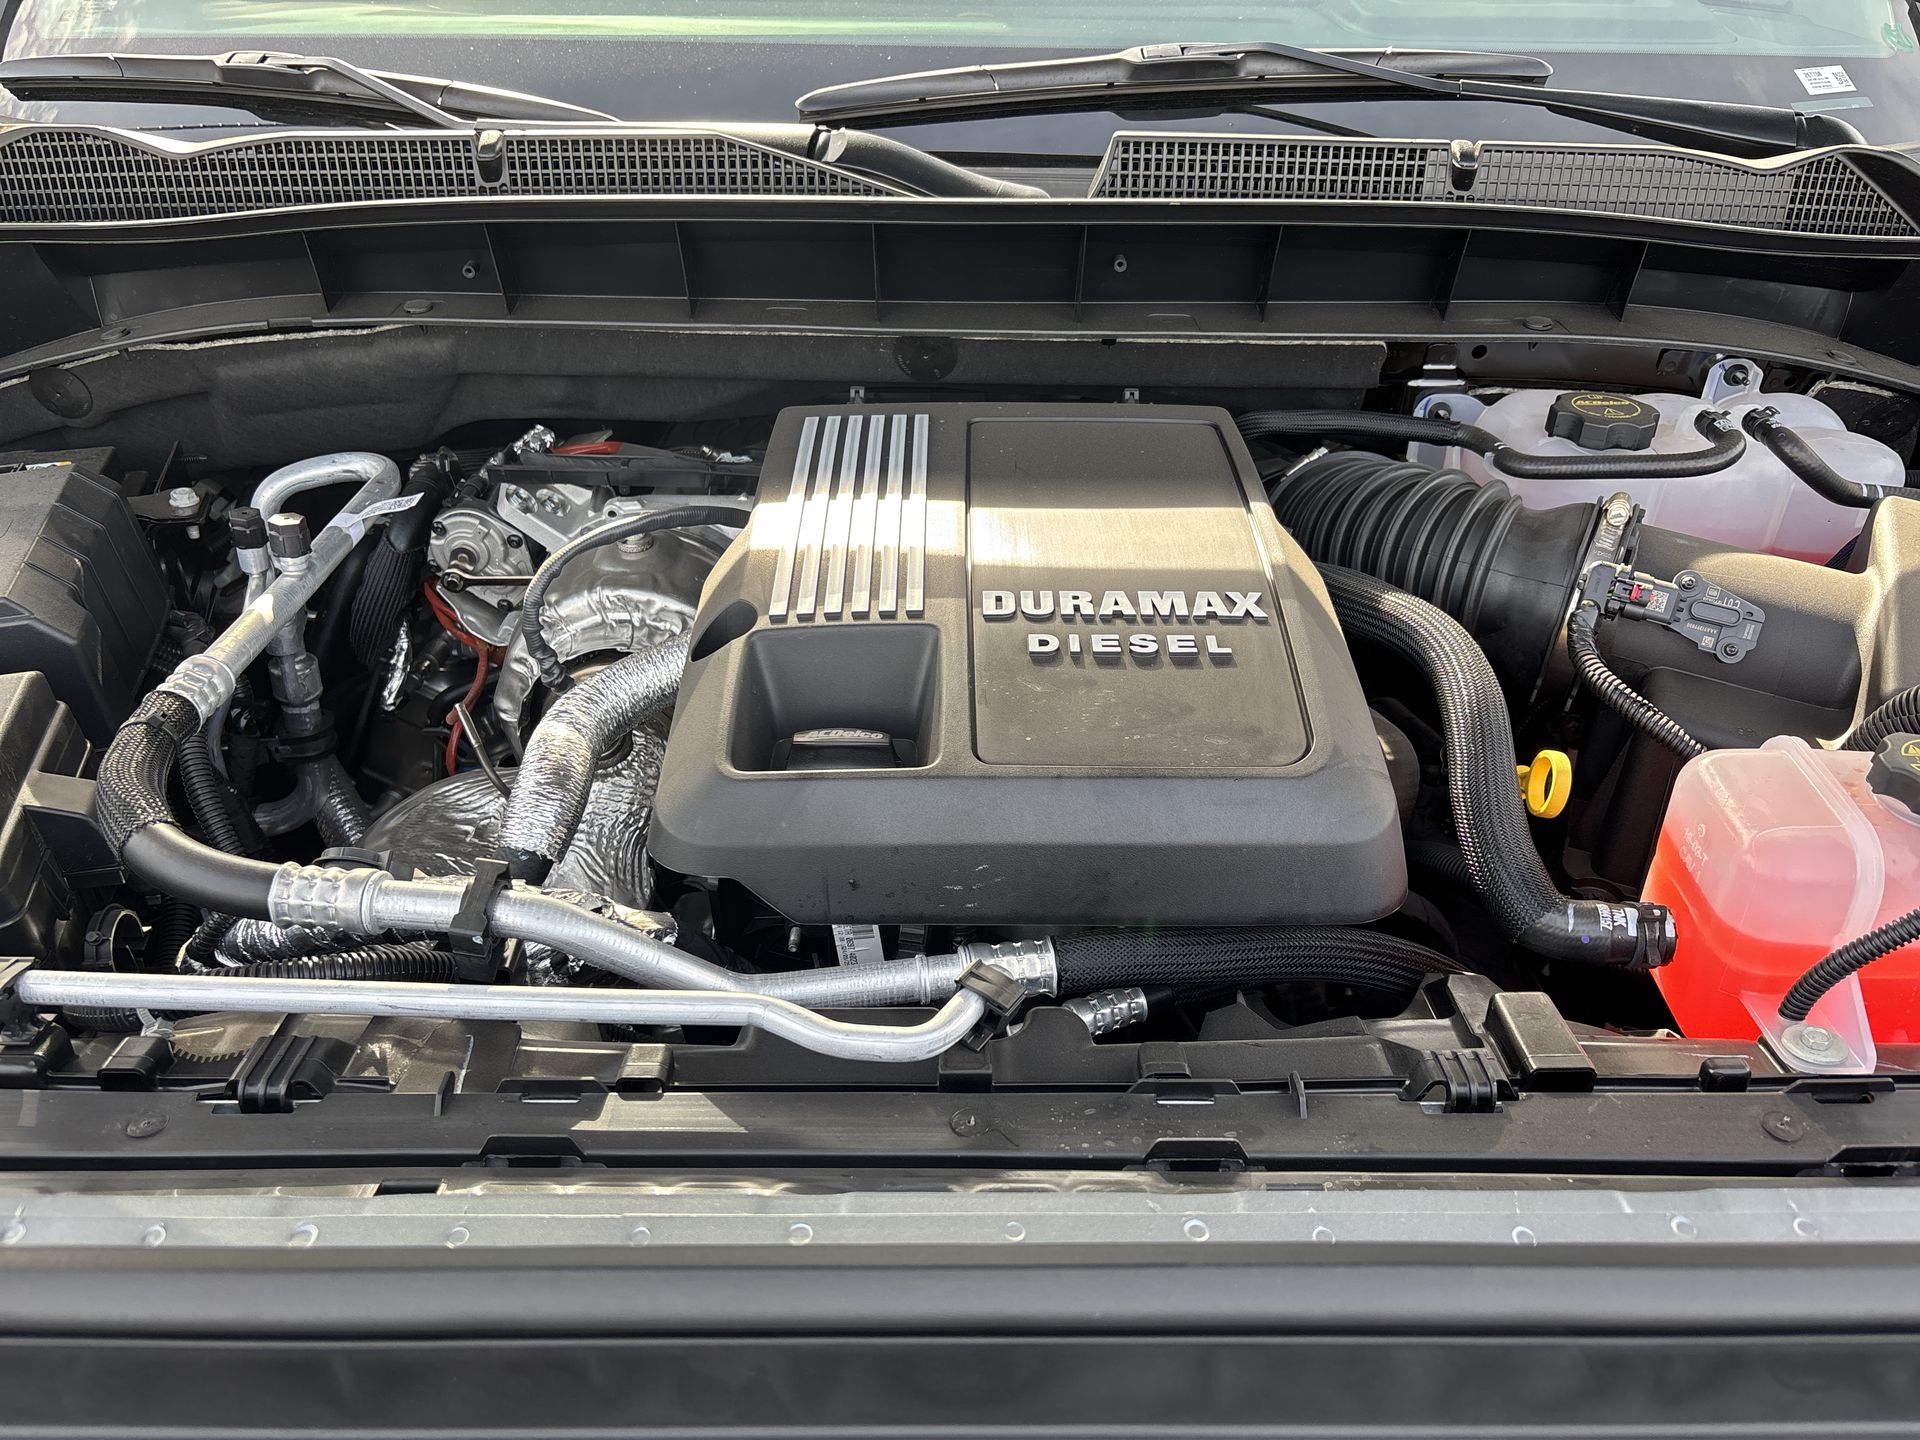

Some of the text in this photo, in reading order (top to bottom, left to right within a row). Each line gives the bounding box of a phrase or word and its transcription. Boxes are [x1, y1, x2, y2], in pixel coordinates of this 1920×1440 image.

[982, 590, 1269, 621] DURAMAX
[1027, 634, 1233, 656] DIESEL
[806, 729, 884, 739] ACDelco
